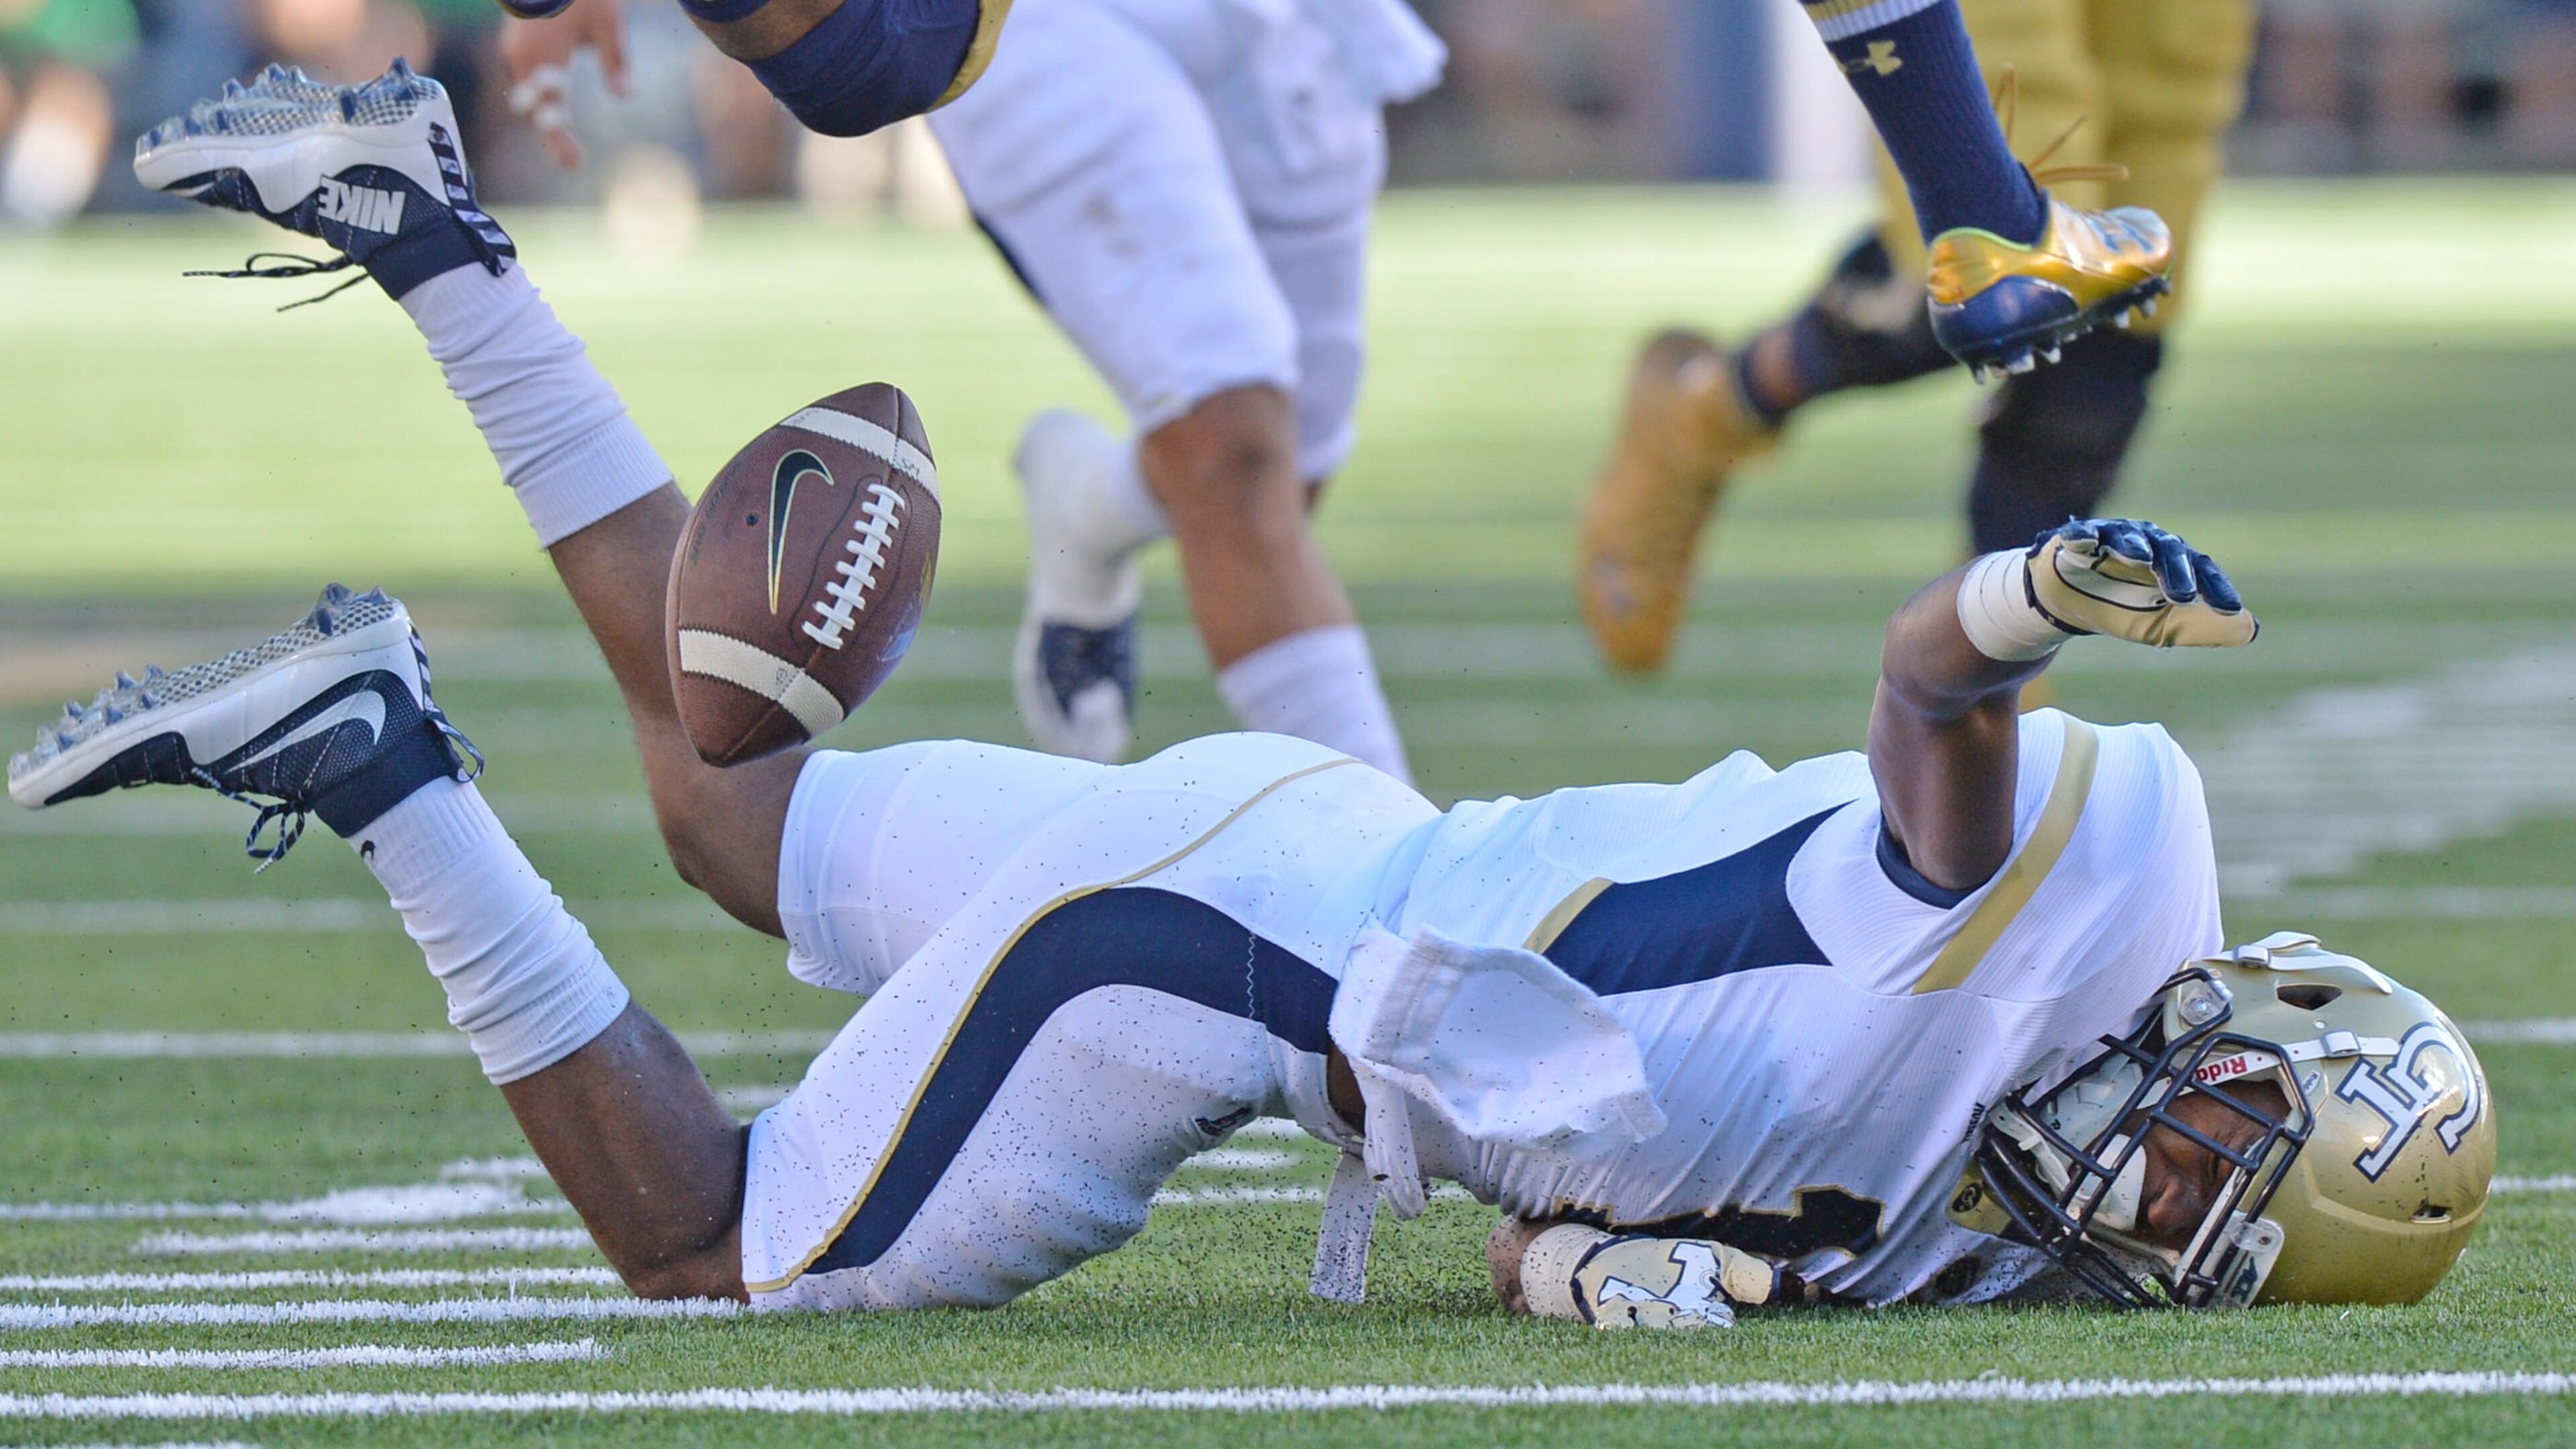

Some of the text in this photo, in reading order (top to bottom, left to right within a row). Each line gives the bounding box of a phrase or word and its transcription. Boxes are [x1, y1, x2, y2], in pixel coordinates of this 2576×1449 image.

[318, 175, 406, 235] NIKE
[2191, 1054, 2248, 1084] Ridd
[2334, 1022, 2480, 1184] GT
